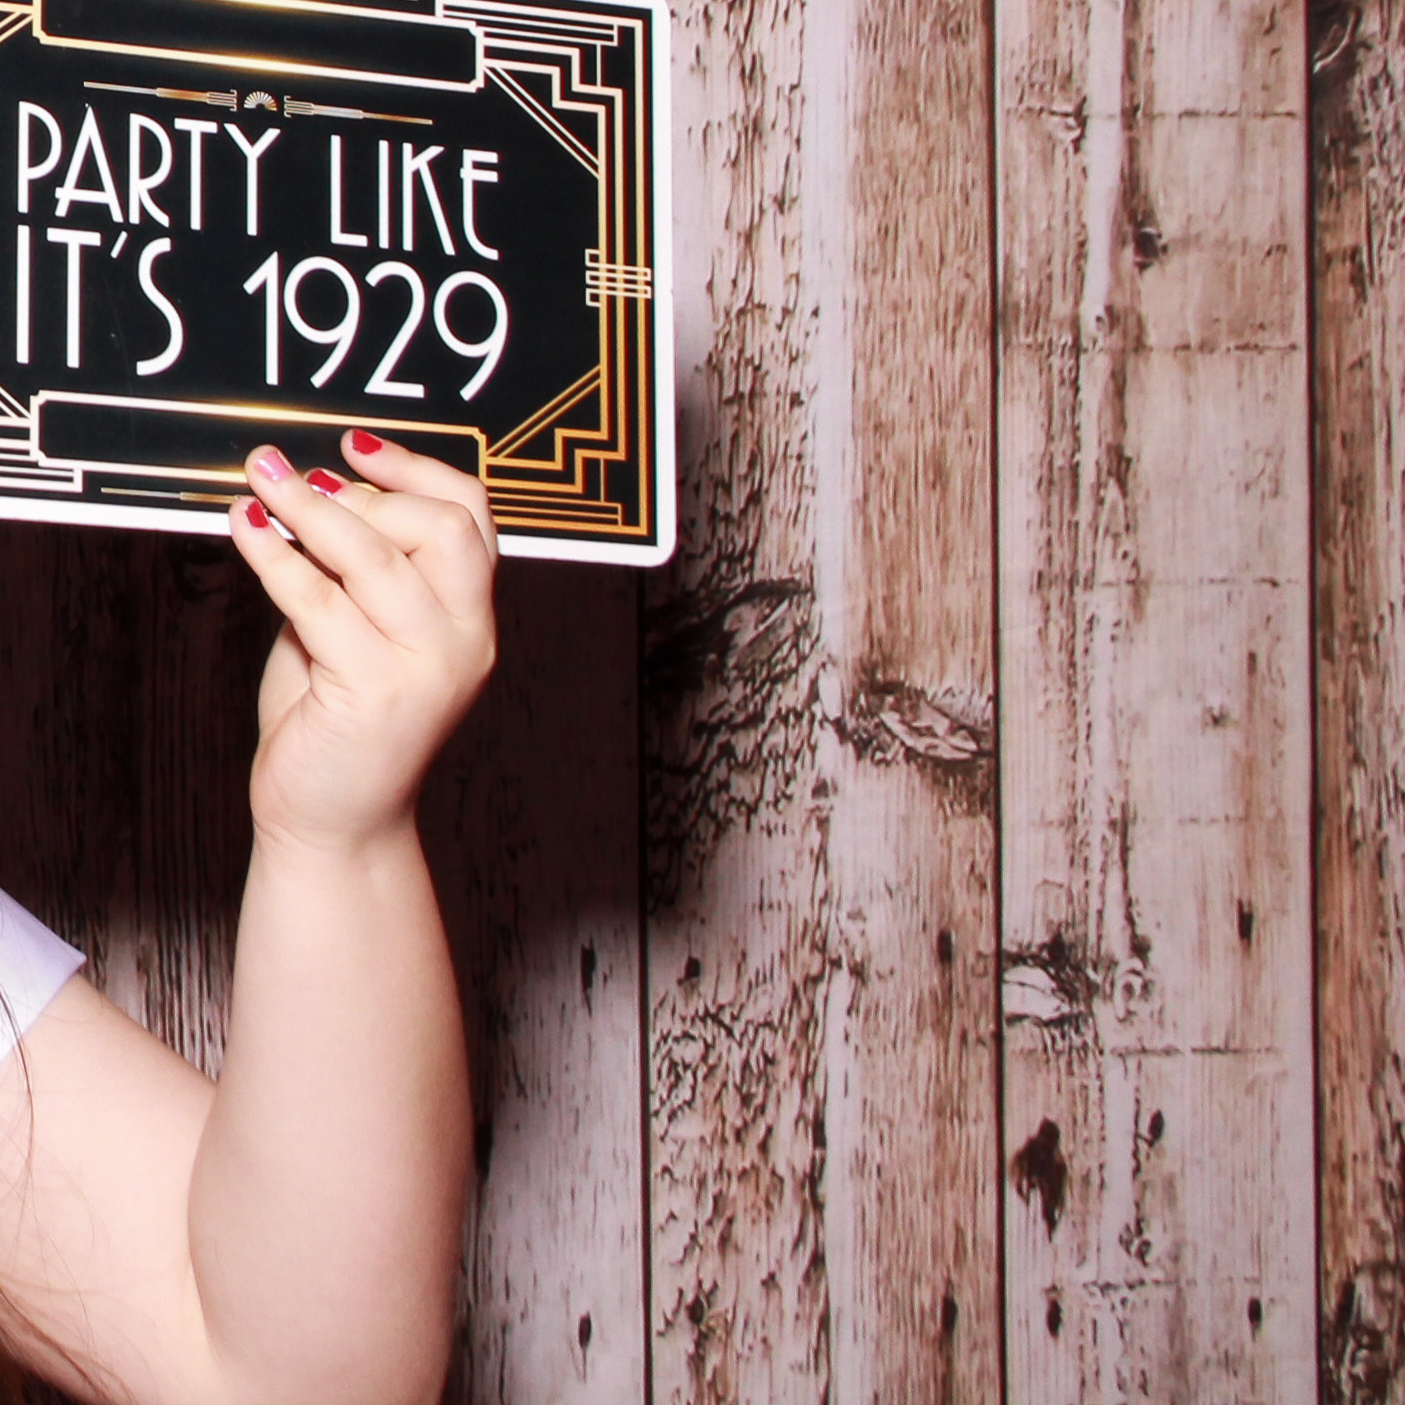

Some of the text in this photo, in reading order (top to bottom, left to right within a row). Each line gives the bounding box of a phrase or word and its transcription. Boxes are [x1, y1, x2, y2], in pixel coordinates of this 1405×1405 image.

[16, 100, 501, 262] PARTY LIKE
[15, 223, 511, 403] IT'S 1929
